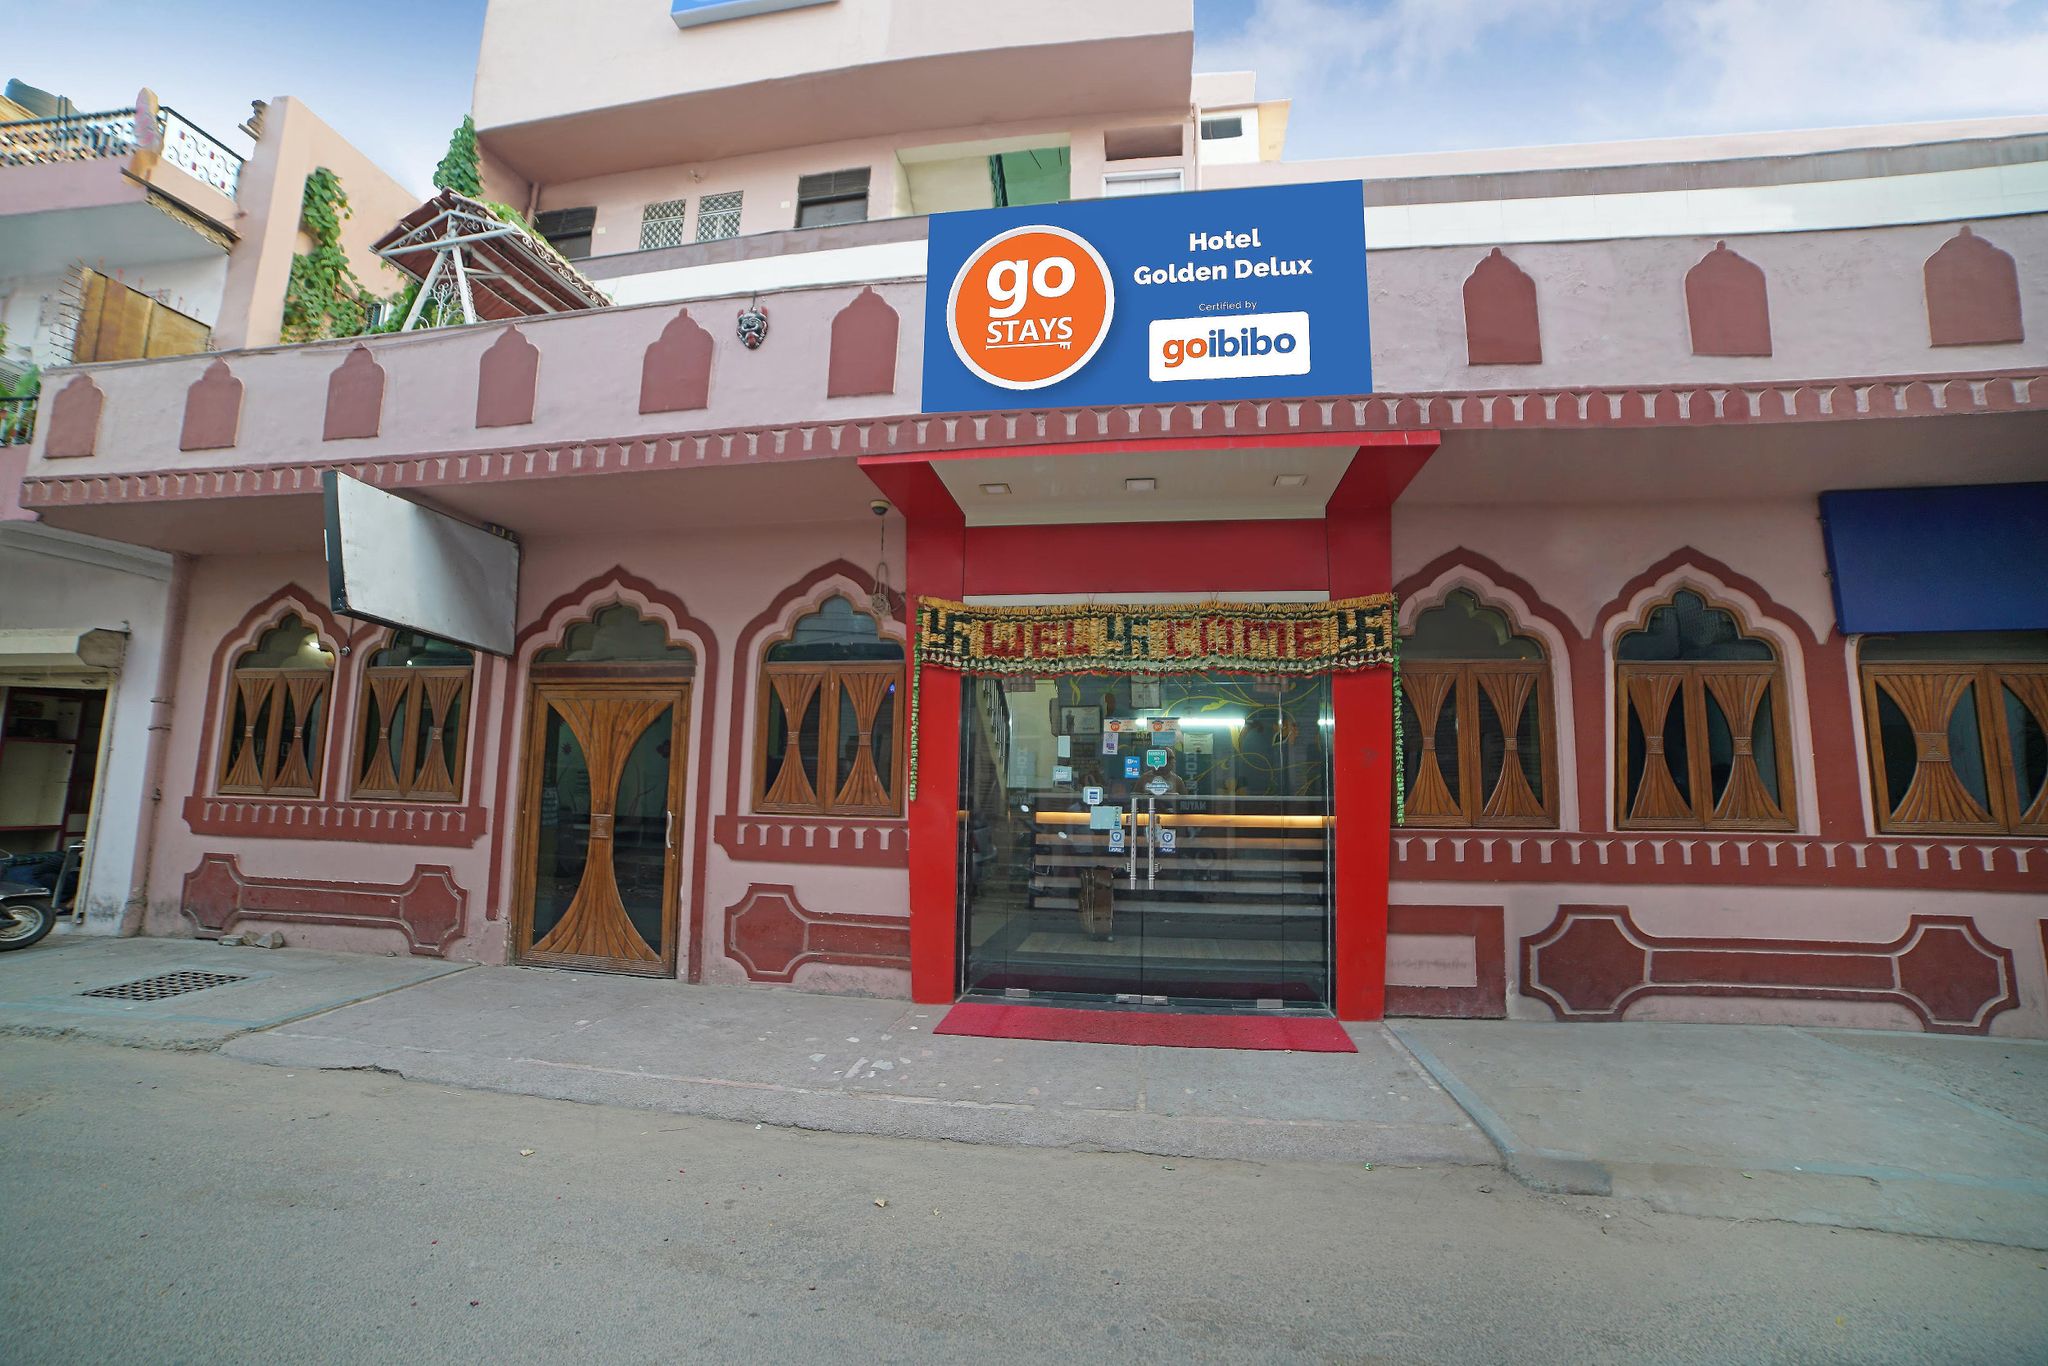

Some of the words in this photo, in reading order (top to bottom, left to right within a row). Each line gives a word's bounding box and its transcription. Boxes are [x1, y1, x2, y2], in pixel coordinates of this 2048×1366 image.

[1189, 228, 1262, 252] Hotel
[1133, 263, 1228, 286] Golden
[1234, 257, 1313, 280] Delux
[985, 255, 1076, 319] go
[1198, 301, 1242, 312] Certified
[1244, 301, 1258, 312] by
[986, 315, 1074, 344] STAYS
[1161, 326, 1297, 369] goibibo
